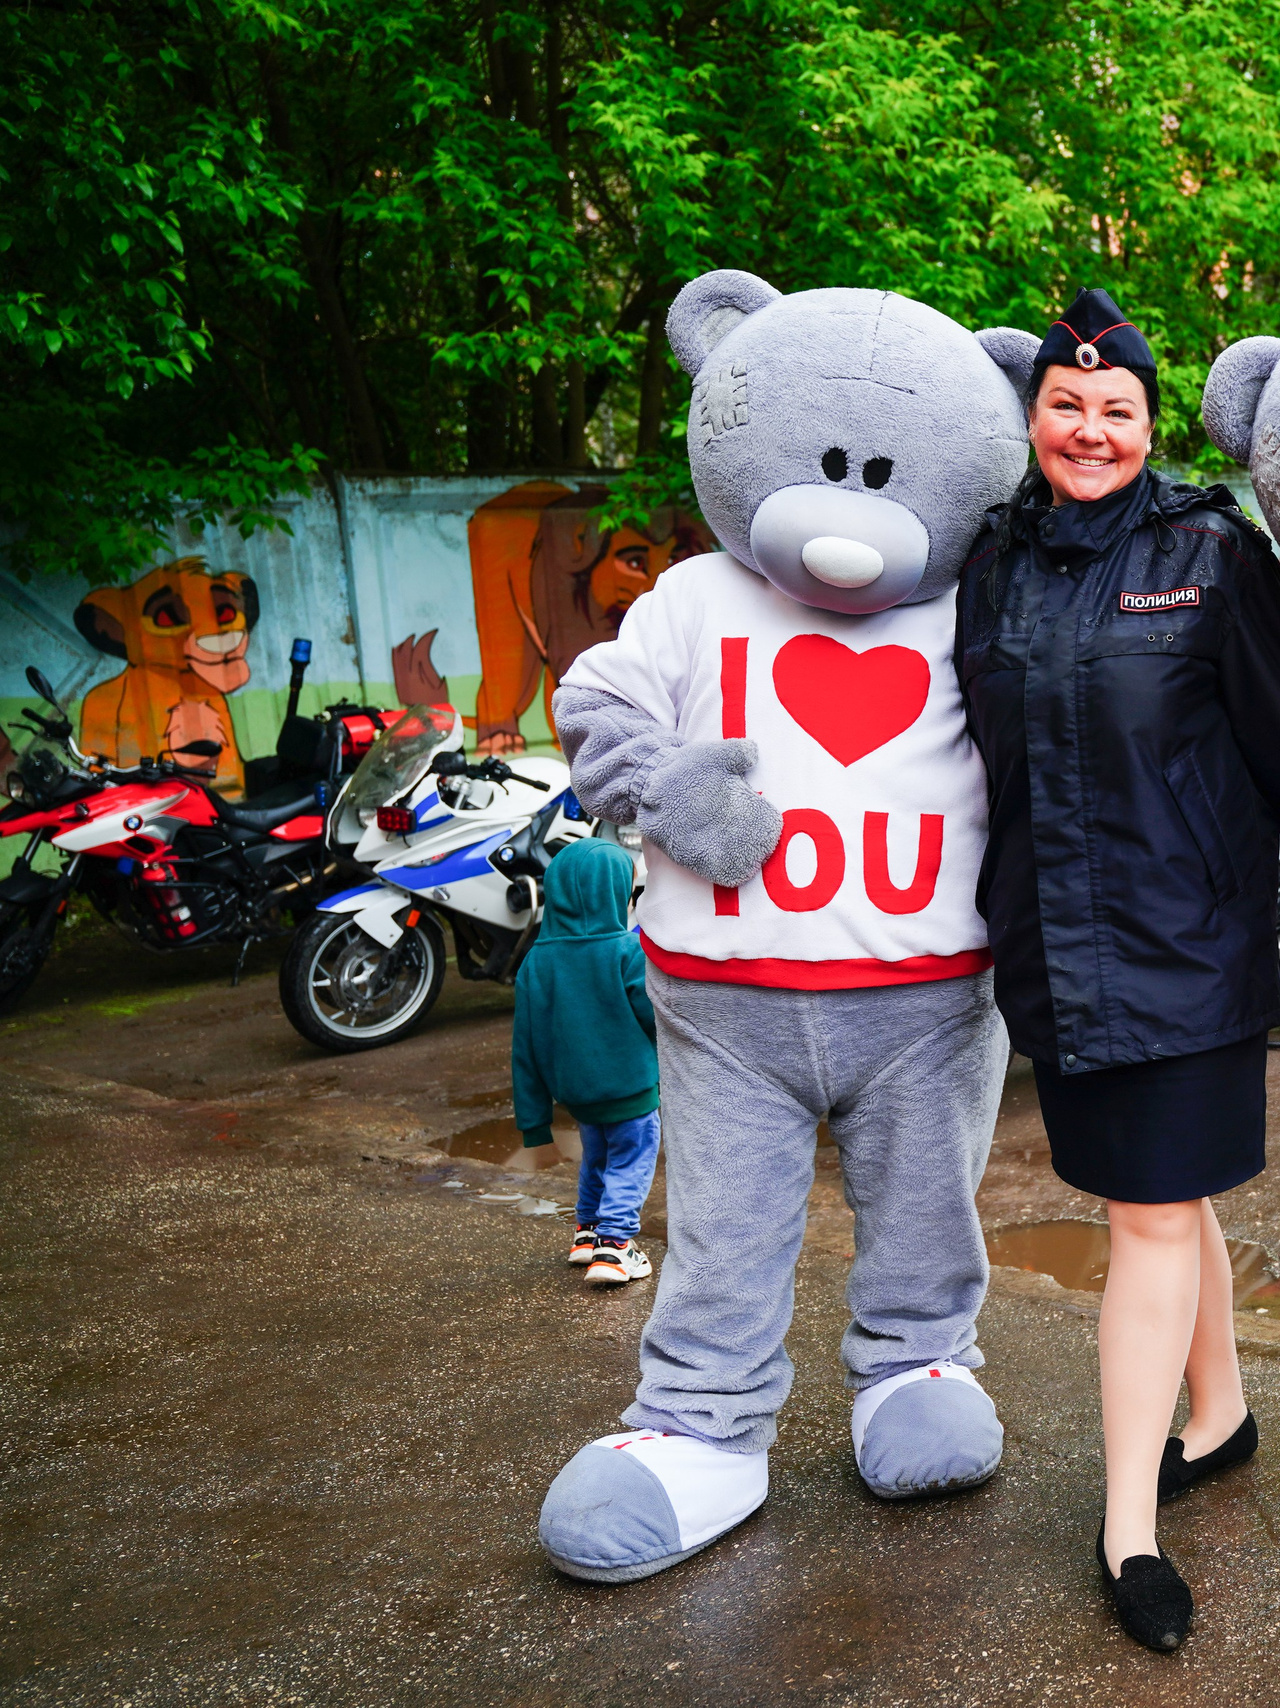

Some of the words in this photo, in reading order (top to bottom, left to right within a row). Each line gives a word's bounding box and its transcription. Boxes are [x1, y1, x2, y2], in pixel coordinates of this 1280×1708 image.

[1124, 589, 1196, 608] ПОЛИЦИЯ
[720, 637, 749, 739] I
[712, 791, 944, 917] OU
